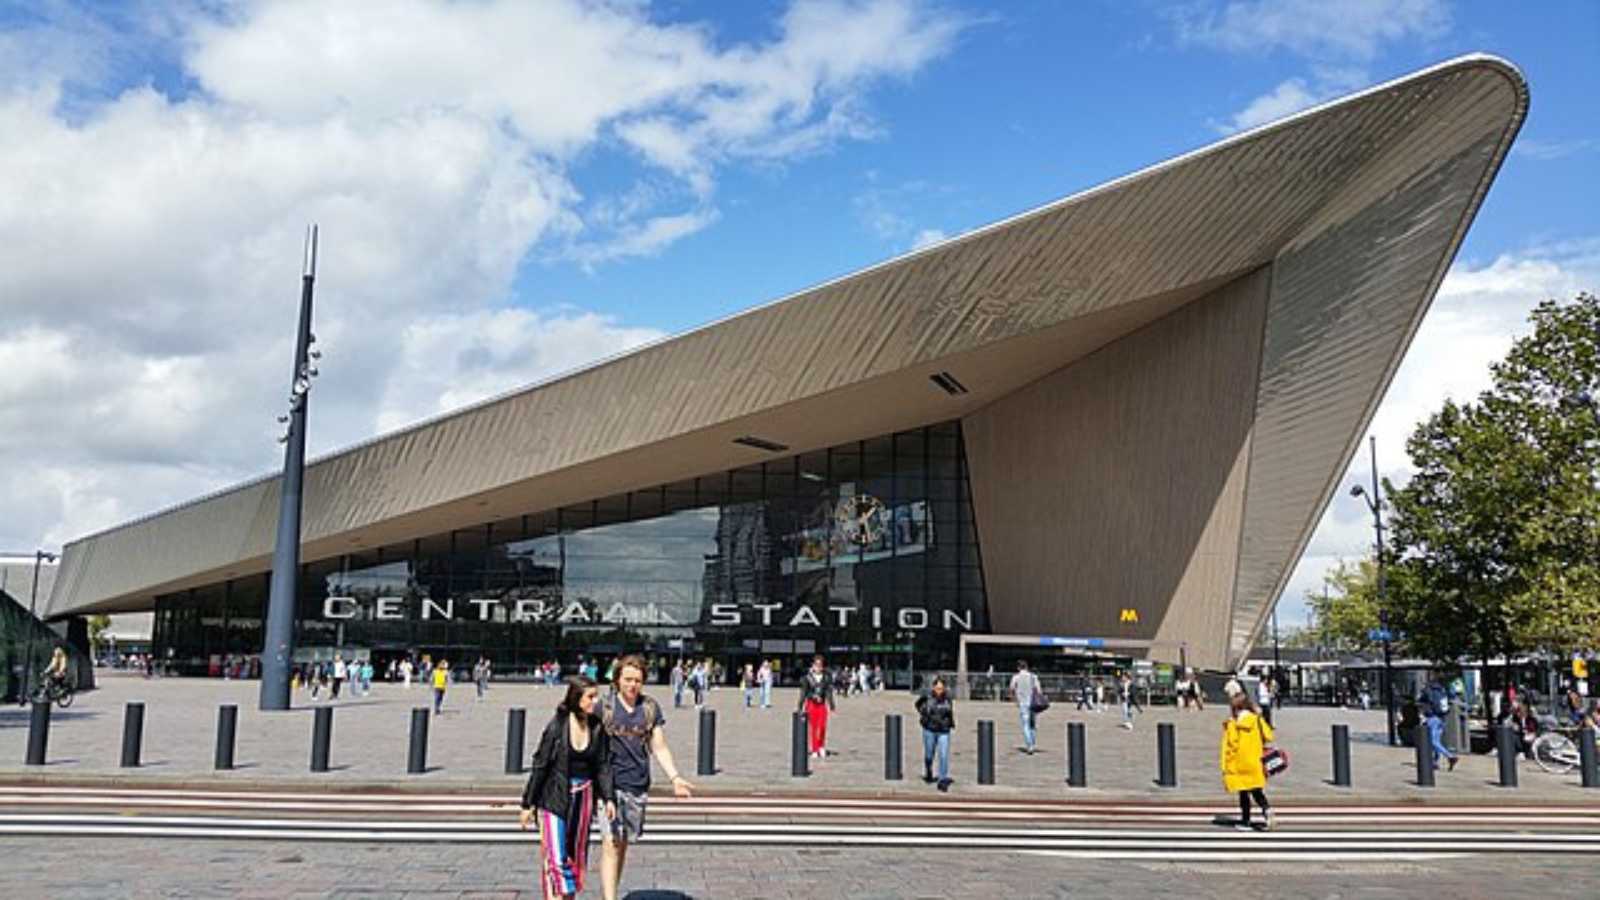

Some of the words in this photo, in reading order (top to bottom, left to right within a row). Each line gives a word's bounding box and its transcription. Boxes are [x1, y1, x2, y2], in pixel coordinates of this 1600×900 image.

[323, 597, 675, 623] CENTRAAL
[711, 602, 972, 629] STATION
[1121, 608, 1138, 622] M
